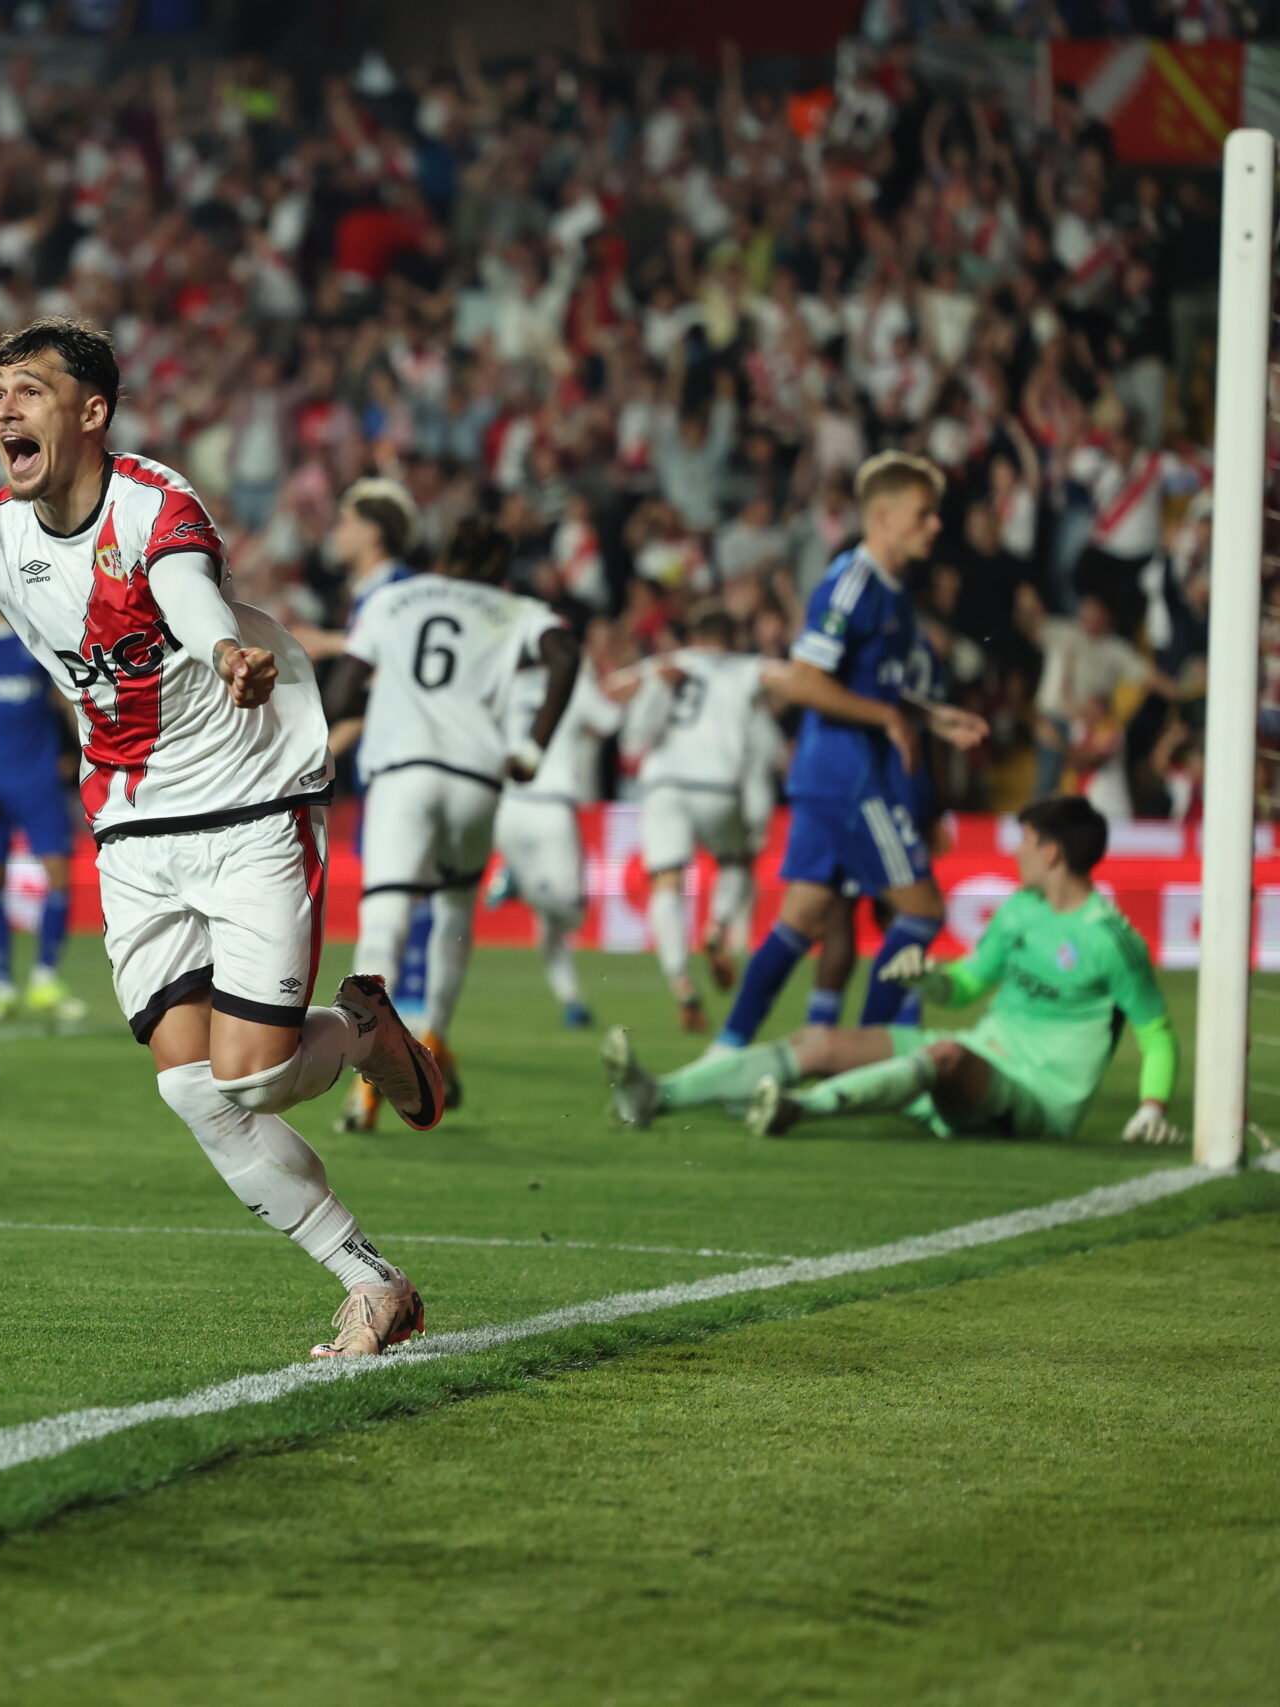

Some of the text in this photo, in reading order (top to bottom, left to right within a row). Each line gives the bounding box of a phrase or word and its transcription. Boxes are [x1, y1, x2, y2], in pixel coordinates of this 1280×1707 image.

[26, 576, 51, 584] umbro
[54, 618, 184, 689] DIGI
[414, 614, 462, 692] 6
[352, 1247, 392, 1282] TAPEDESIGN
